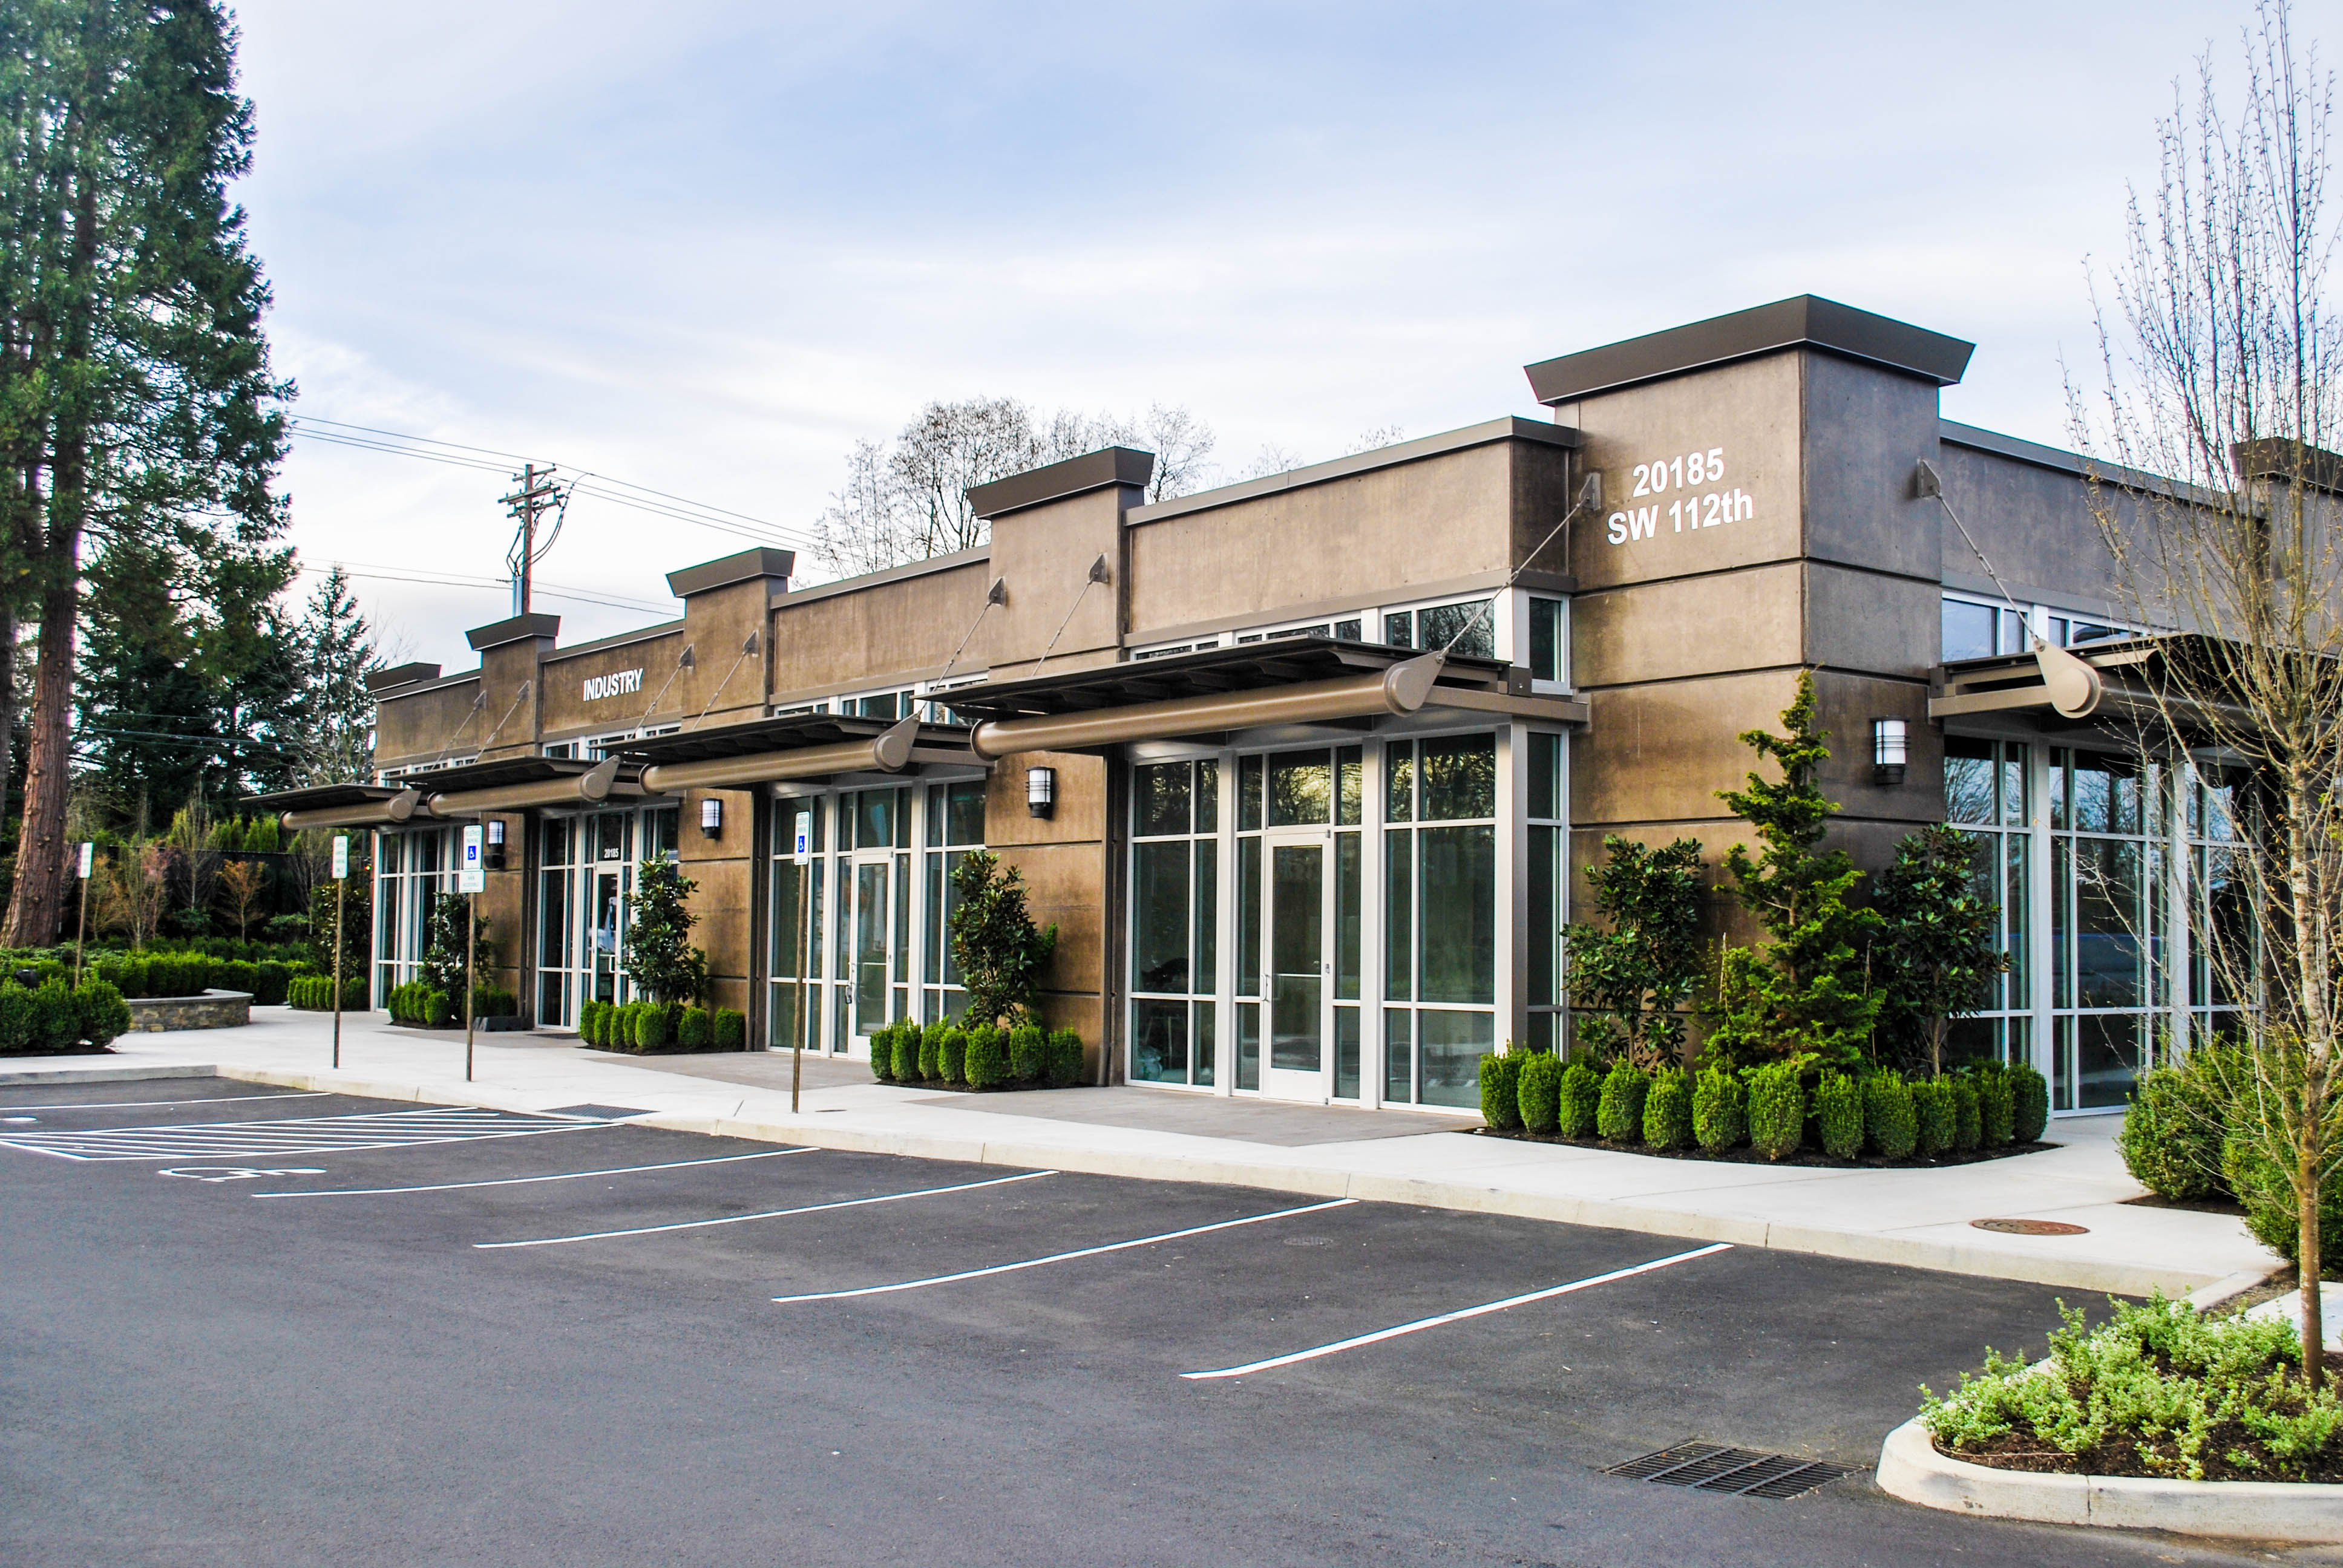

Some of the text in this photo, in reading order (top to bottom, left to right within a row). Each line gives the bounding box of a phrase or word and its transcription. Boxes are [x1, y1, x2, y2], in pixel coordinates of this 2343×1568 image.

[1632, 447, 1725, 498] 20185
[1607, 488, 1754, 545] SW 112th
[583, 667, 644, 702] INDUSTRY
